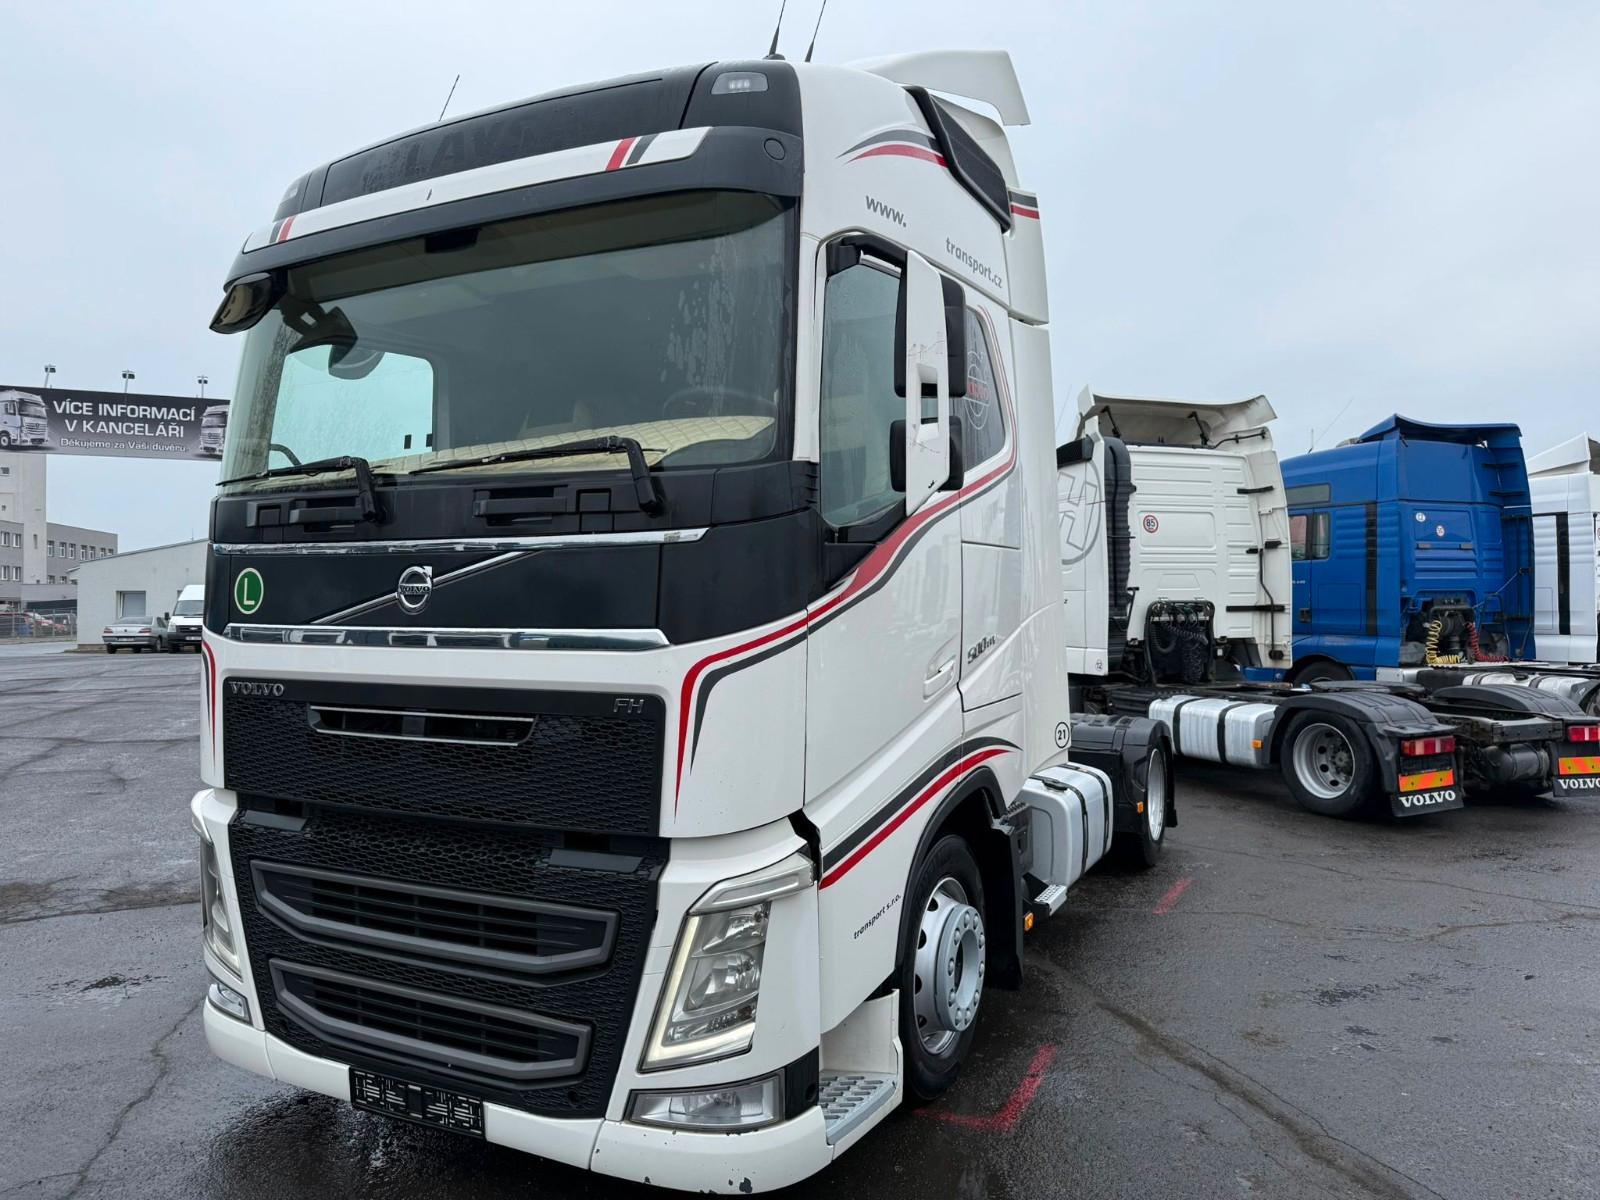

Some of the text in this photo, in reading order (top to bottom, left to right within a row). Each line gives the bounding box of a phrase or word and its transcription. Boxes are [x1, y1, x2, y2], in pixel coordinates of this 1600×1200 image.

[866, 195, 907, 228] www.
[946, 237, 1003, 289] transport.cz
[53, 398, 196, 421] VÍCE INFORMACÍ
[65, 419, 185, 438] V KANCELÁŘI
[244, 577, 255, 605] L
[400, 585, 431, 594] VOLVO
[229, 681, 285, 696] VOLVO
[613, 698, 644, 714] FH
[1057, 729, 1066, 741] 21
[1399, 790, 1456, 808] VOLVO
[853, 893, 902, 939] transport s.r.o.
